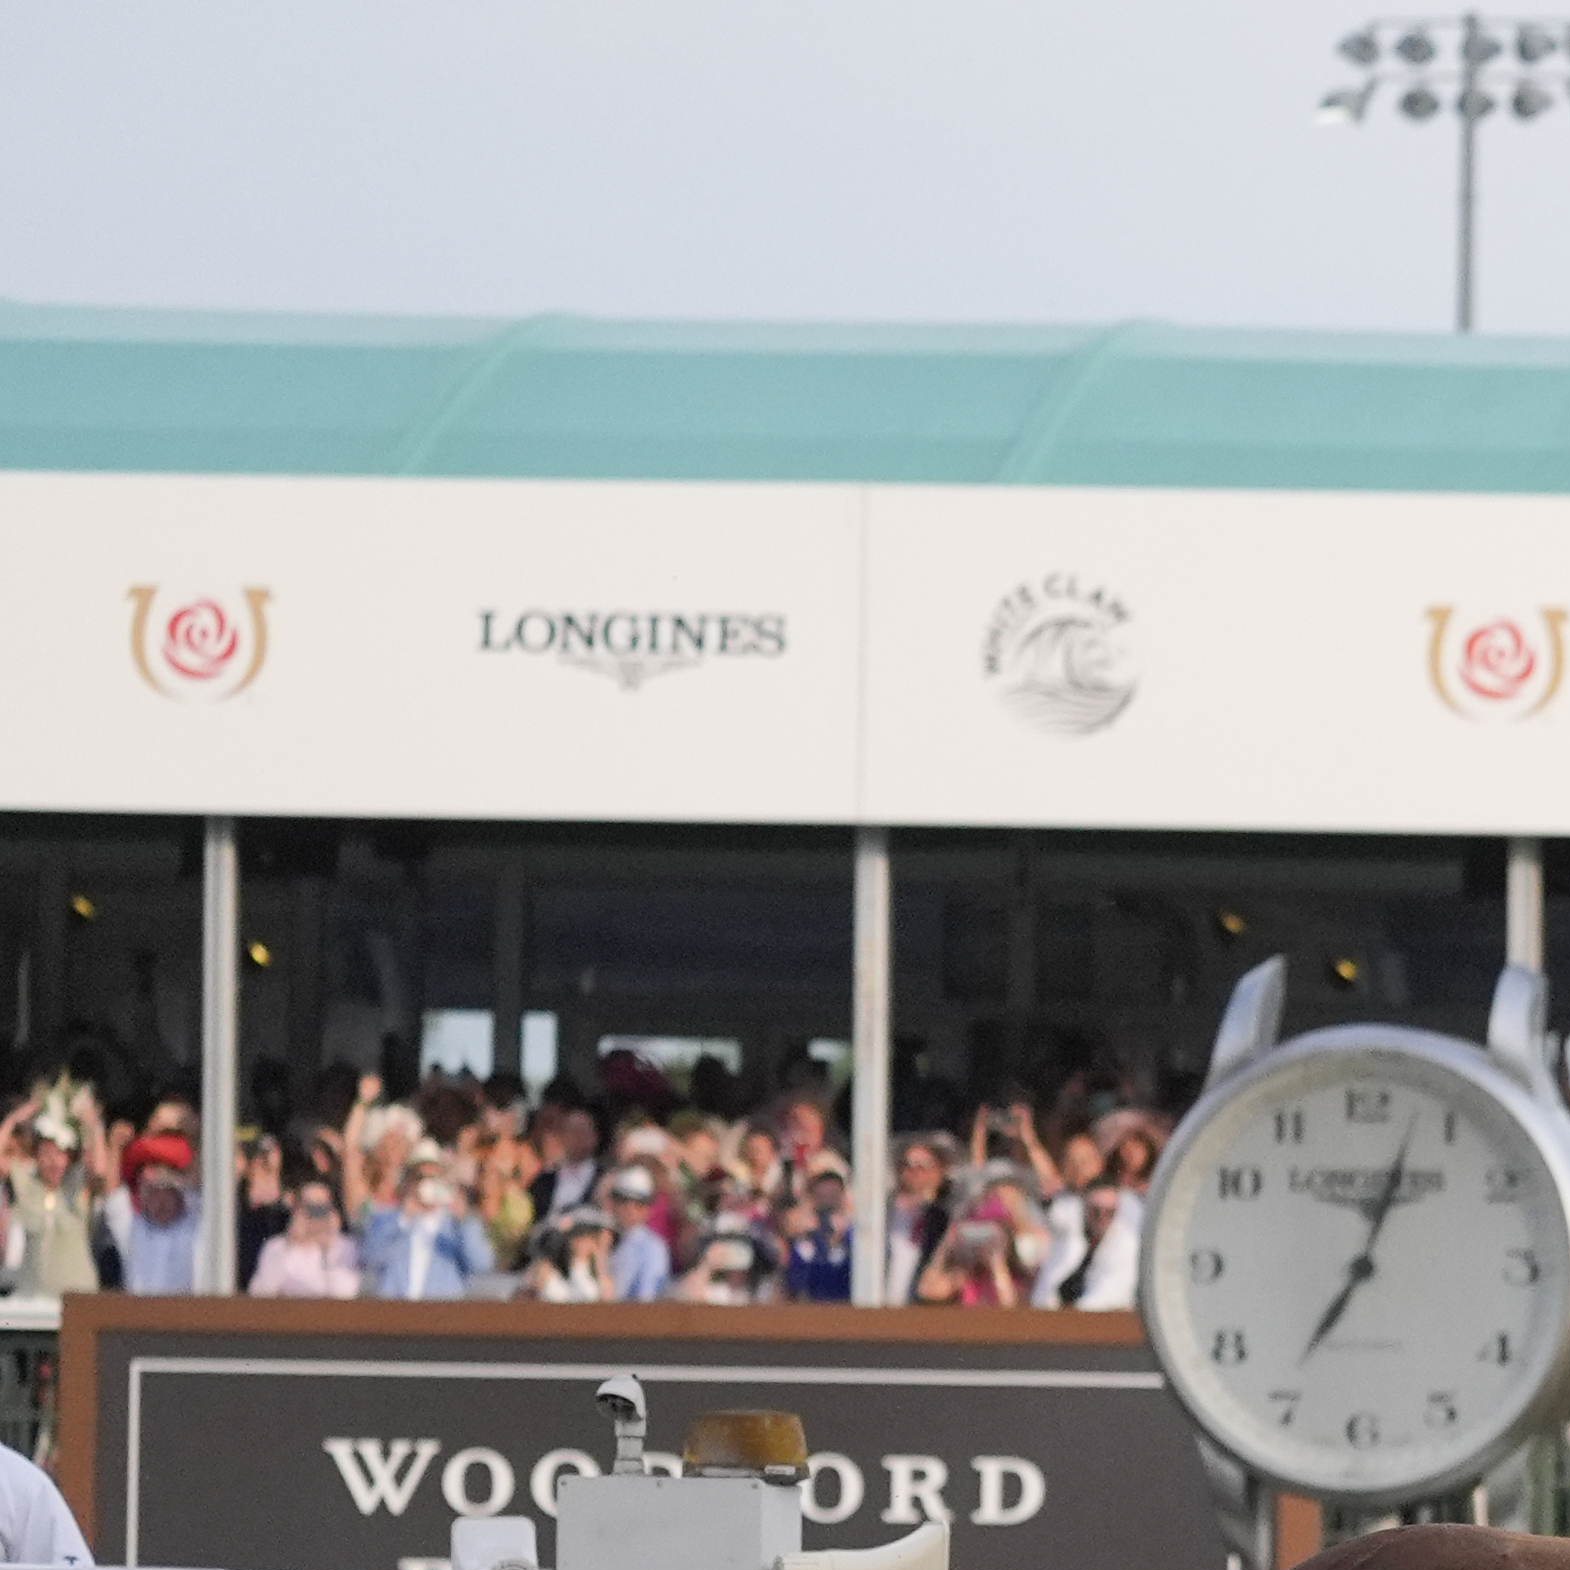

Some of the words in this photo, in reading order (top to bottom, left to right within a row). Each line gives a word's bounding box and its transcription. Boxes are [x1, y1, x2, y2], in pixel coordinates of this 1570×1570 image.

[479, 608, 787, 656] LONGINES
[1346, 1088, 1389, 1123] 12
[1275, 1108, 1302, 1144] 11
[1443, 1112, 1456, 1145] 1
[1218, 1166, 1262, 1200] 10
[1190, 1248, 1224, 1284] 9
[1503, 1248, 1539, 1286] 3
[1211, 1329, 1247, 1365] 8
[1268, 1390, 1300, 1425] 7
[1346, 1412, 1380, 1448] 6
[325, 1436, 1046, 1525] WOOORD
